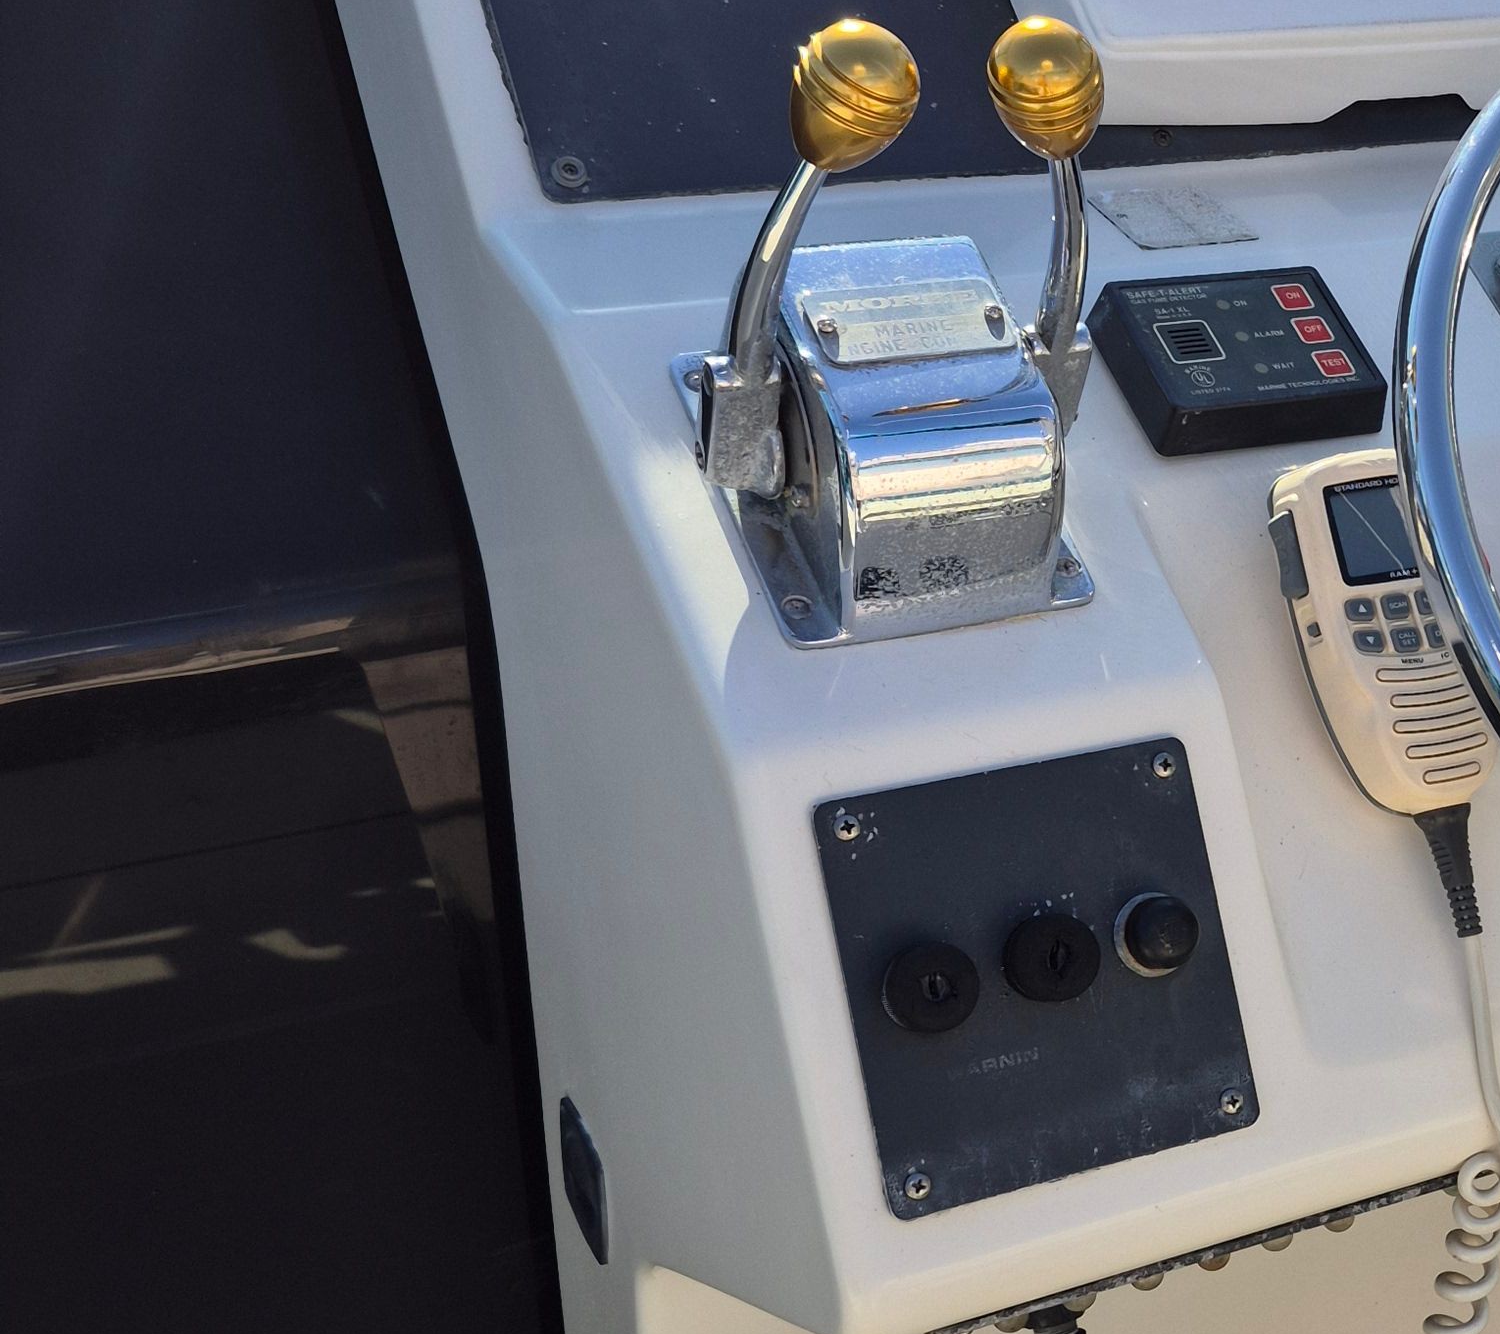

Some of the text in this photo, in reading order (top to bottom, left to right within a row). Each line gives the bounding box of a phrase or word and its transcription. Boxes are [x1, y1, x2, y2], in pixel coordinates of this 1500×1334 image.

[1285, 291, 1300, 299] ON
[874, 319, 954, 338] MARINE
[1304, 325, 1322, 333] OFF
[1254, 329, 1284, 339] ALARM
[848, 339, 906, 356] NGINE
[1272, 362, 1295, 370] WAIT
[1321, 358, 1346, 367] TEST
[1334, 478, 1382, 493] STANDARD
[1388, 601, 1408, 609] SCAN
[1402, 638, 1416, 646] SET
